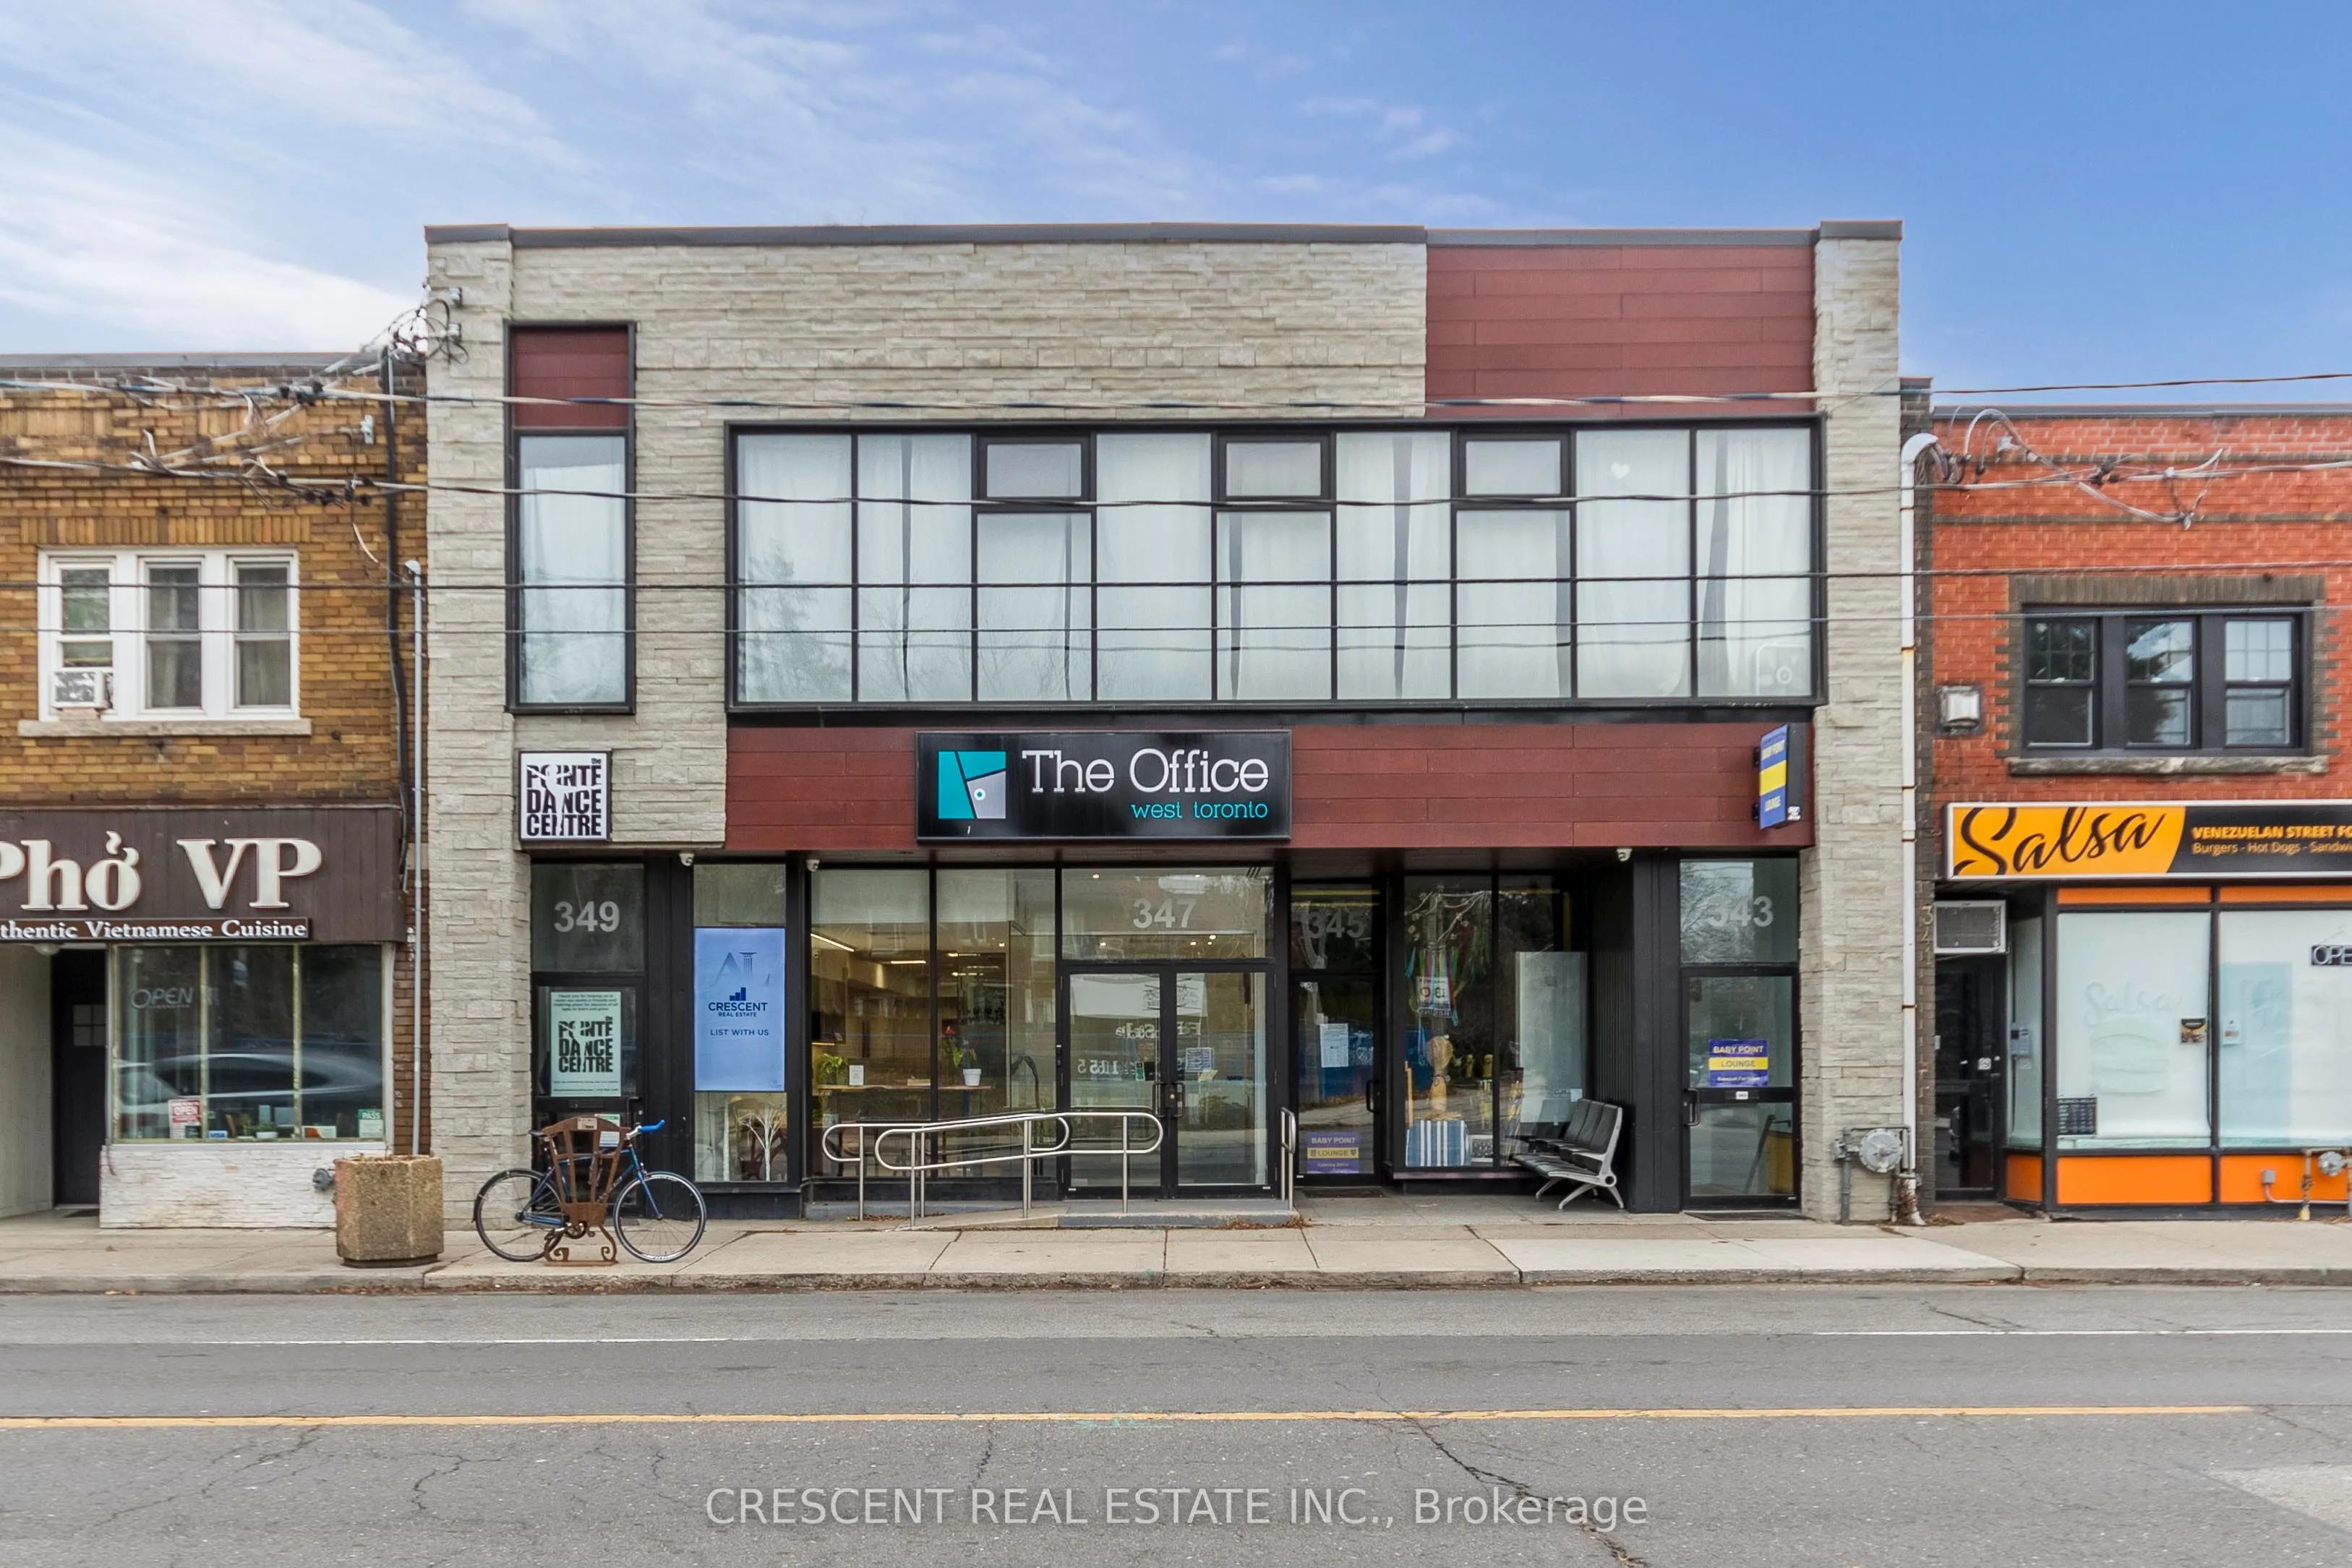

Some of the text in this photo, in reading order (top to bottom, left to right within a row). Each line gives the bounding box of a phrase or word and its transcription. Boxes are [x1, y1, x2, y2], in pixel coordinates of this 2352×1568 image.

[1022, 748, 1269, 793] The Office
[526, 789, 602, 814] DANCE
[1131, 802, 1268, 818] west toronto
[526, 814, 602, 836] CENTRE
[2192, 826, 2284, 839] VENEZUELAN
[2286, 826, 2336, 838] STREET
[1954, 806, 2167, 875] Salsa
[2191, 842, 2238, 856] Burgers
[2247, 842, 2269, 853] Hot
[2271, 841, 2301, 856] Dogs
[176, 838, 323, 909] VP
[554, 901, 620, 933] 349
[1133, 898, 1197, 928] 347
[1707, 894, 1774, 927] 343
[0, 919, 307, 938] thentic Vietnamese Cuisine
[1304, 909, 1365, 938] 345
[2314, 945, 2352, 964] OPE
[131, 988, 194, 1008] OPEN
[708, 1002, 768, 1011] CRESCENT
[559, 1038, 613, 1056] DANCE
[559, 1056, 613, 1074] CENTRE
